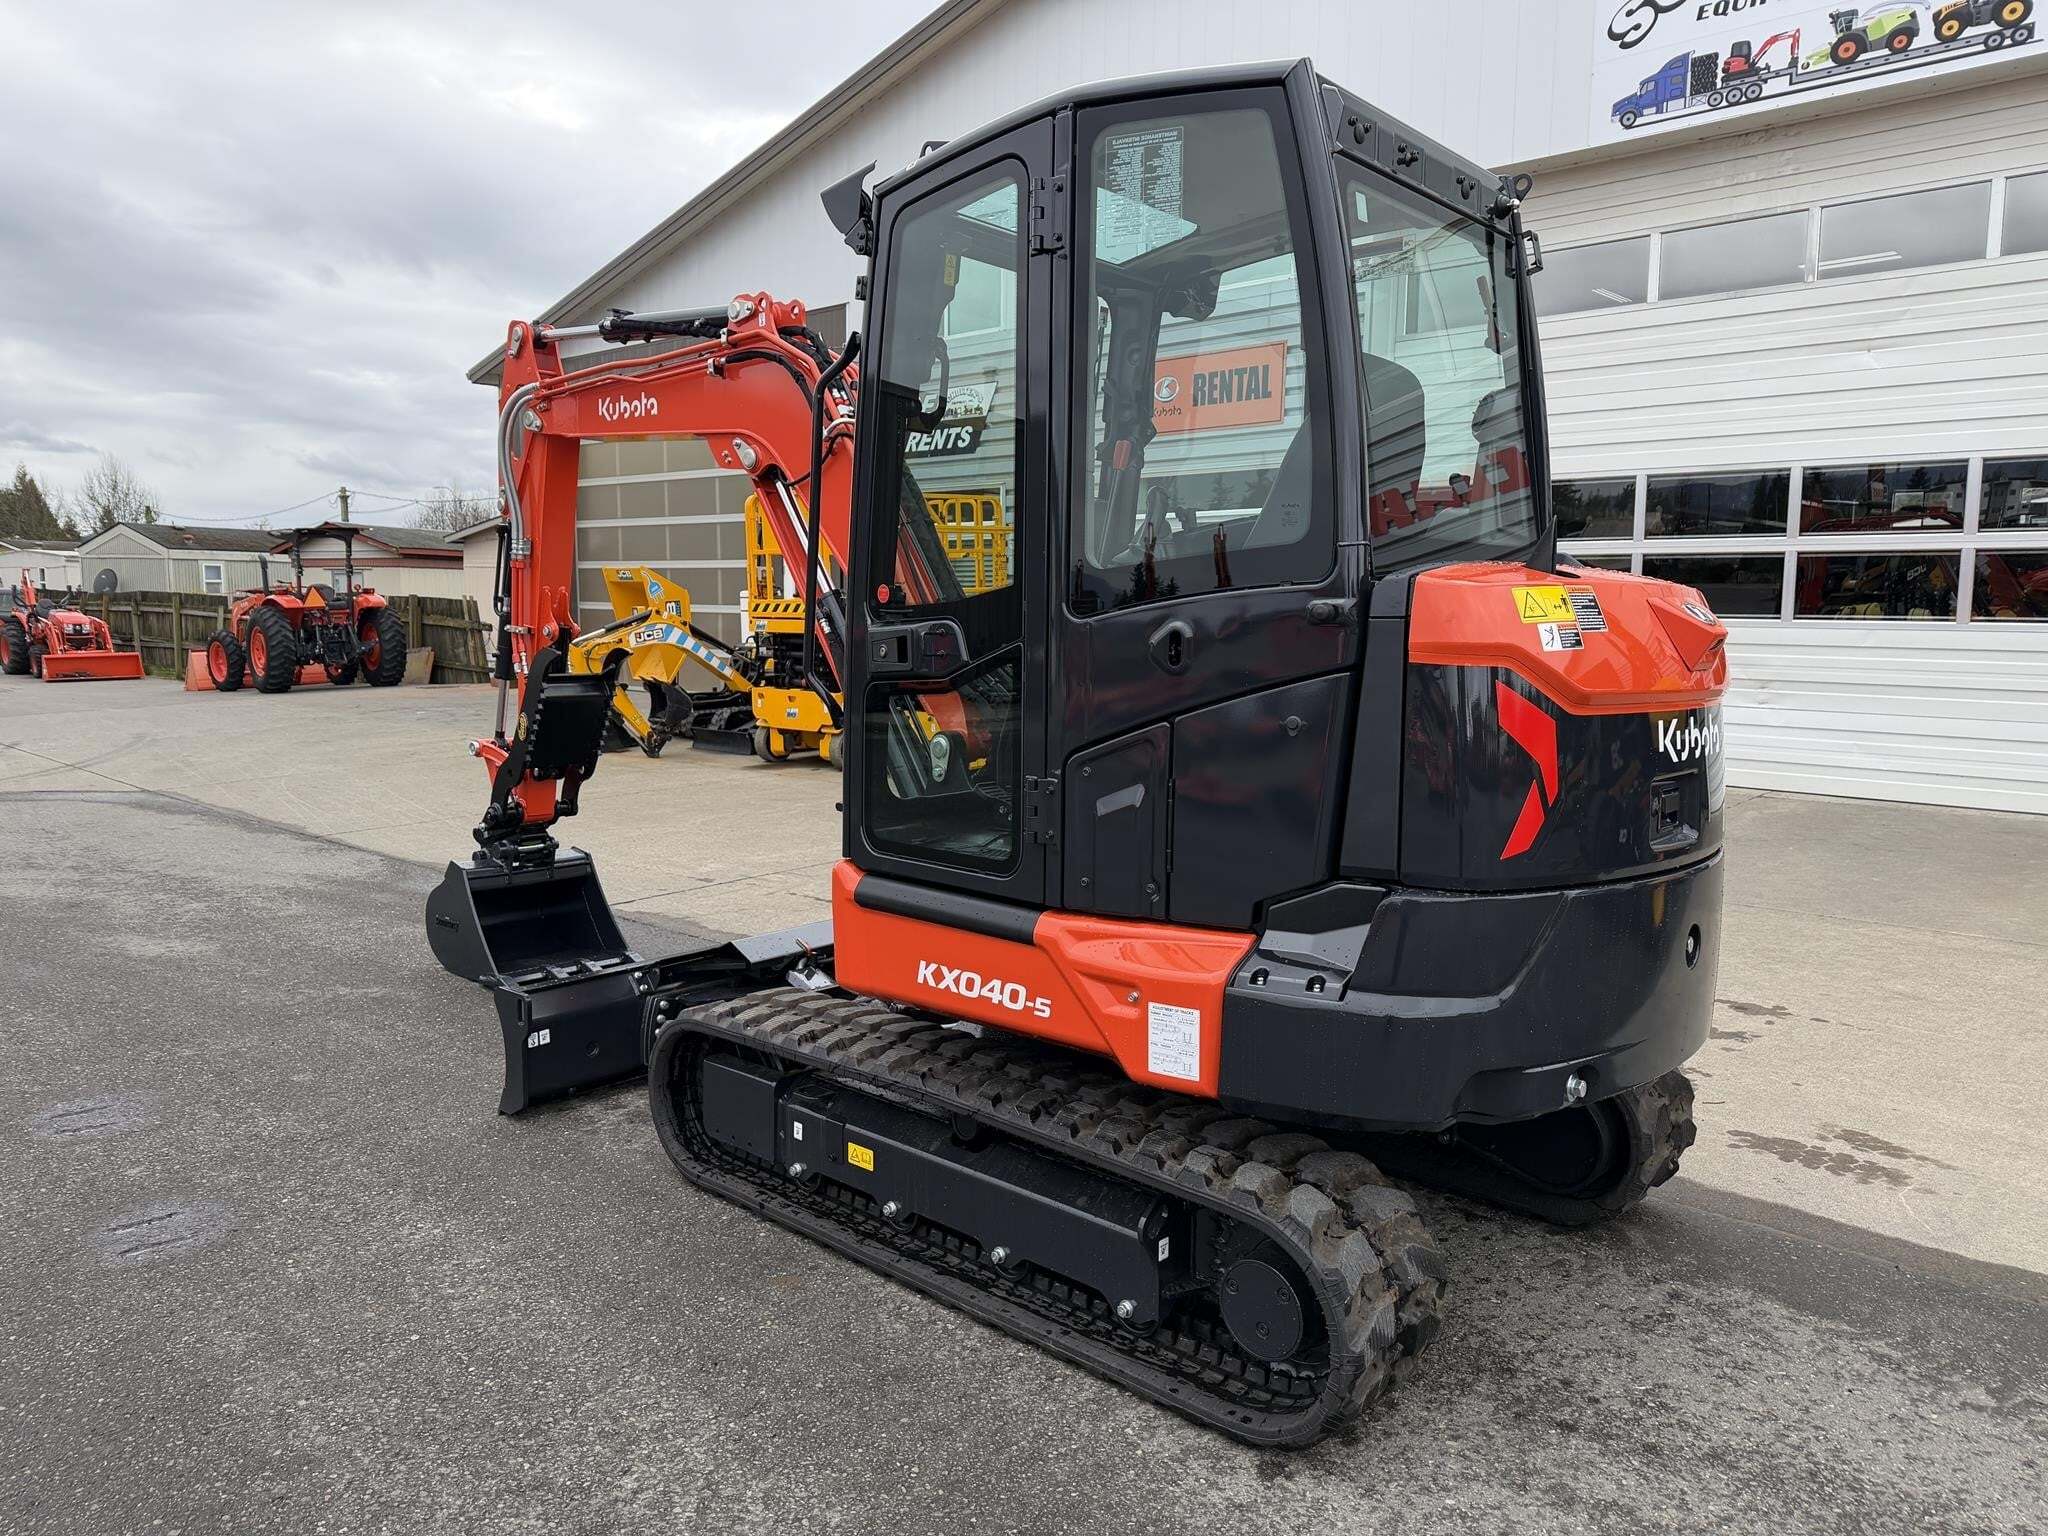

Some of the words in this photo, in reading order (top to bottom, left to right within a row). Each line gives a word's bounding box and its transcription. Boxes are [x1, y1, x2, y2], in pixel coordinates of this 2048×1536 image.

[1192, 364, 1272, 407] RENTAL
[598, 391, 658, 421] Kubota
[905, 425, 973, 453] RENTS
[635, 628, 664, 643] JCB
[1658, 713, 1720, 763] Kubota
[917, 959, 1052, 1018] KX040-5
